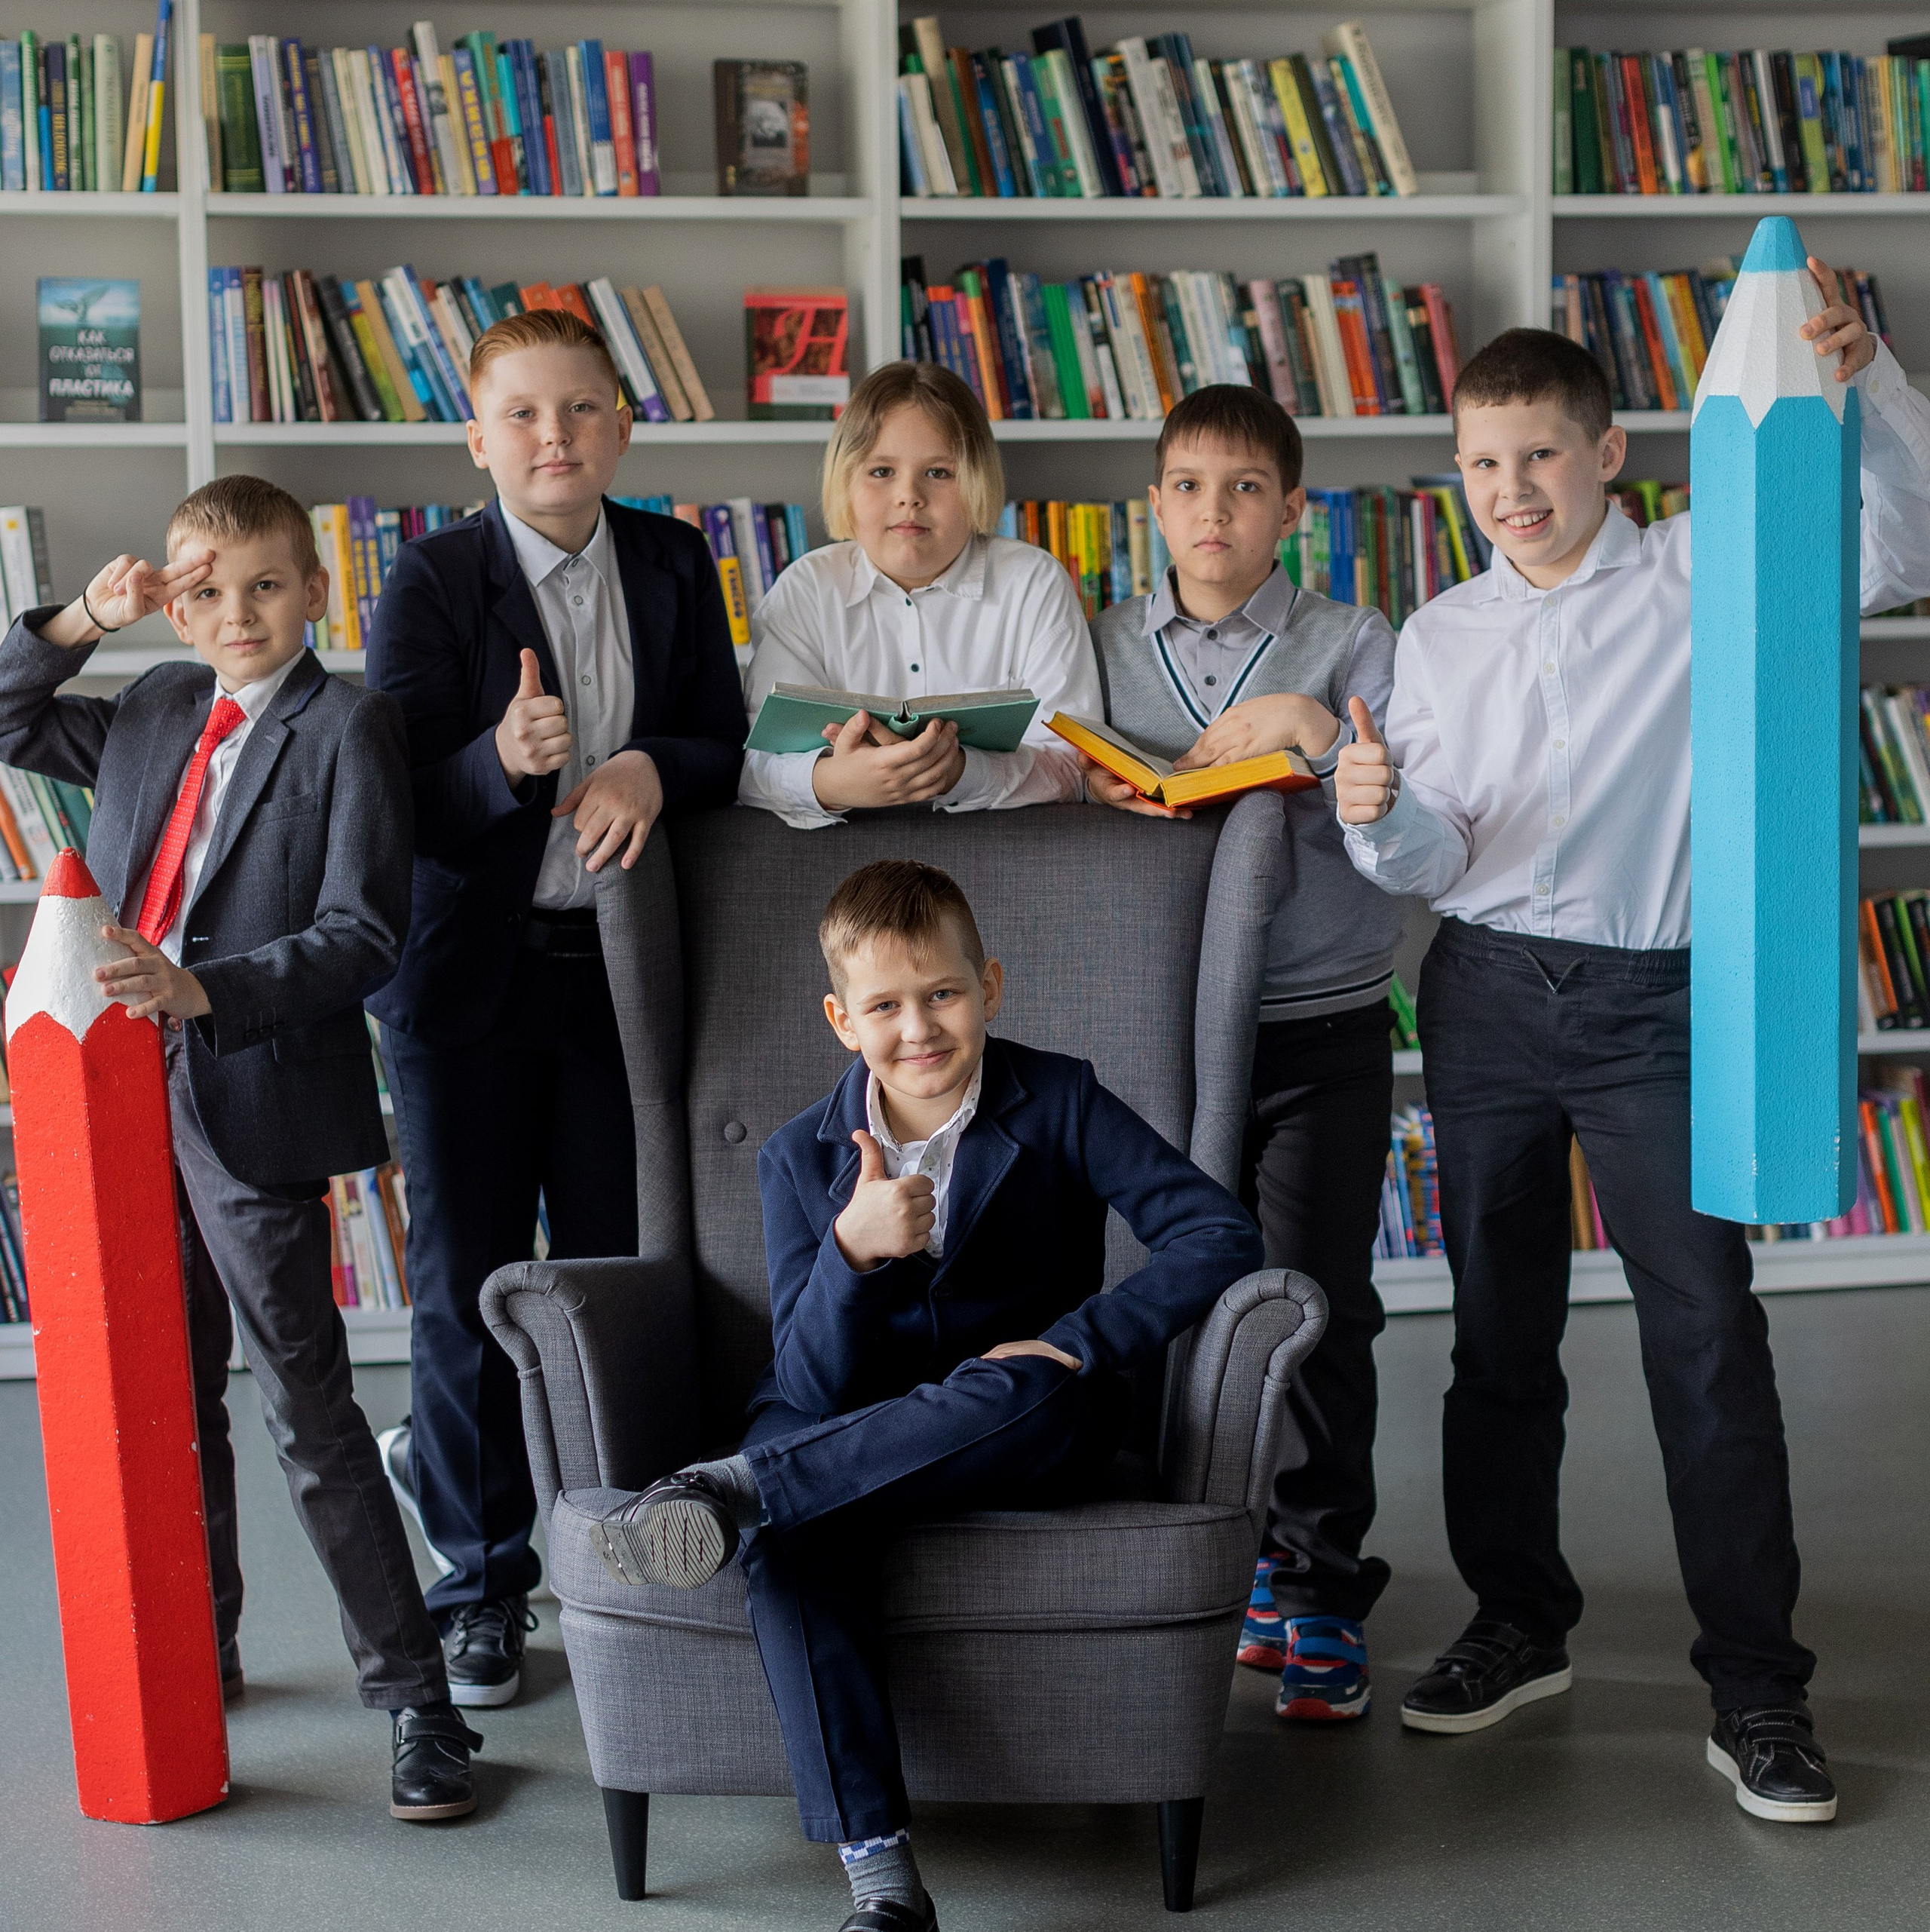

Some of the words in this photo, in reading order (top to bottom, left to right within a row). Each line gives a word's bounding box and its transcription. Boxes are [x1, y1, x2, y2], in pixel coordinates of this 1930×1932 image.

[462, 71, 492, 182] ФИЗИКА
[78, 330, 106, 345] КАК
[49, 346, 135, 363] ОТКАЗАТЬСЯ
[84, 363, 102, 378] ОТ
[48, 378, 136, 397] ПЛАСТИКА
